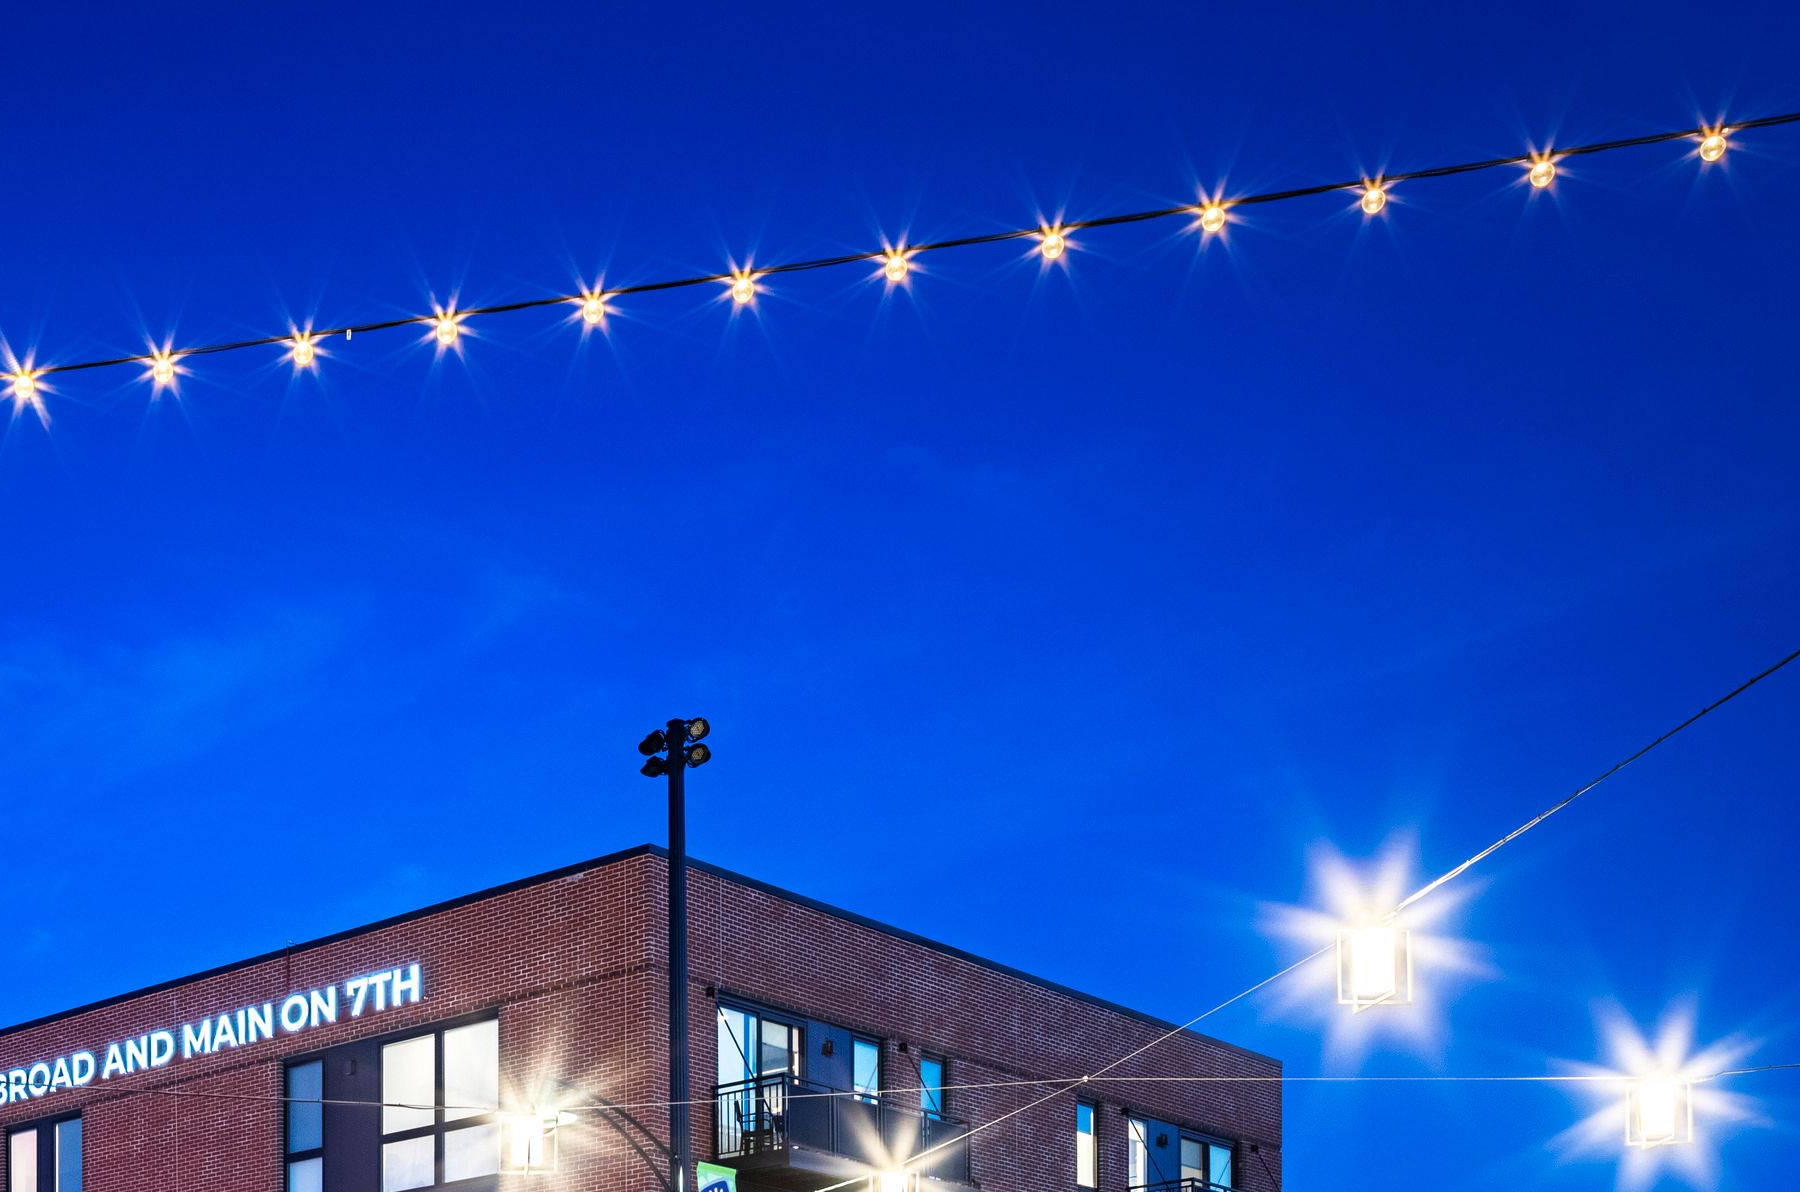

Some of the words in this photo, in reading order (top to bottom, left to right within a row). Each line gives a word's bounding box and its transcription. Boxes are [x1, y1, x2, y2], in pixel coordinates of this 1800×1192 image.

[102, 1031, 174, 1080] AND
[183, 1002, 275, 1058] MAIN
[280, 985, 339, 1033] ON
[345, 963, 423, 1017] 7TH
